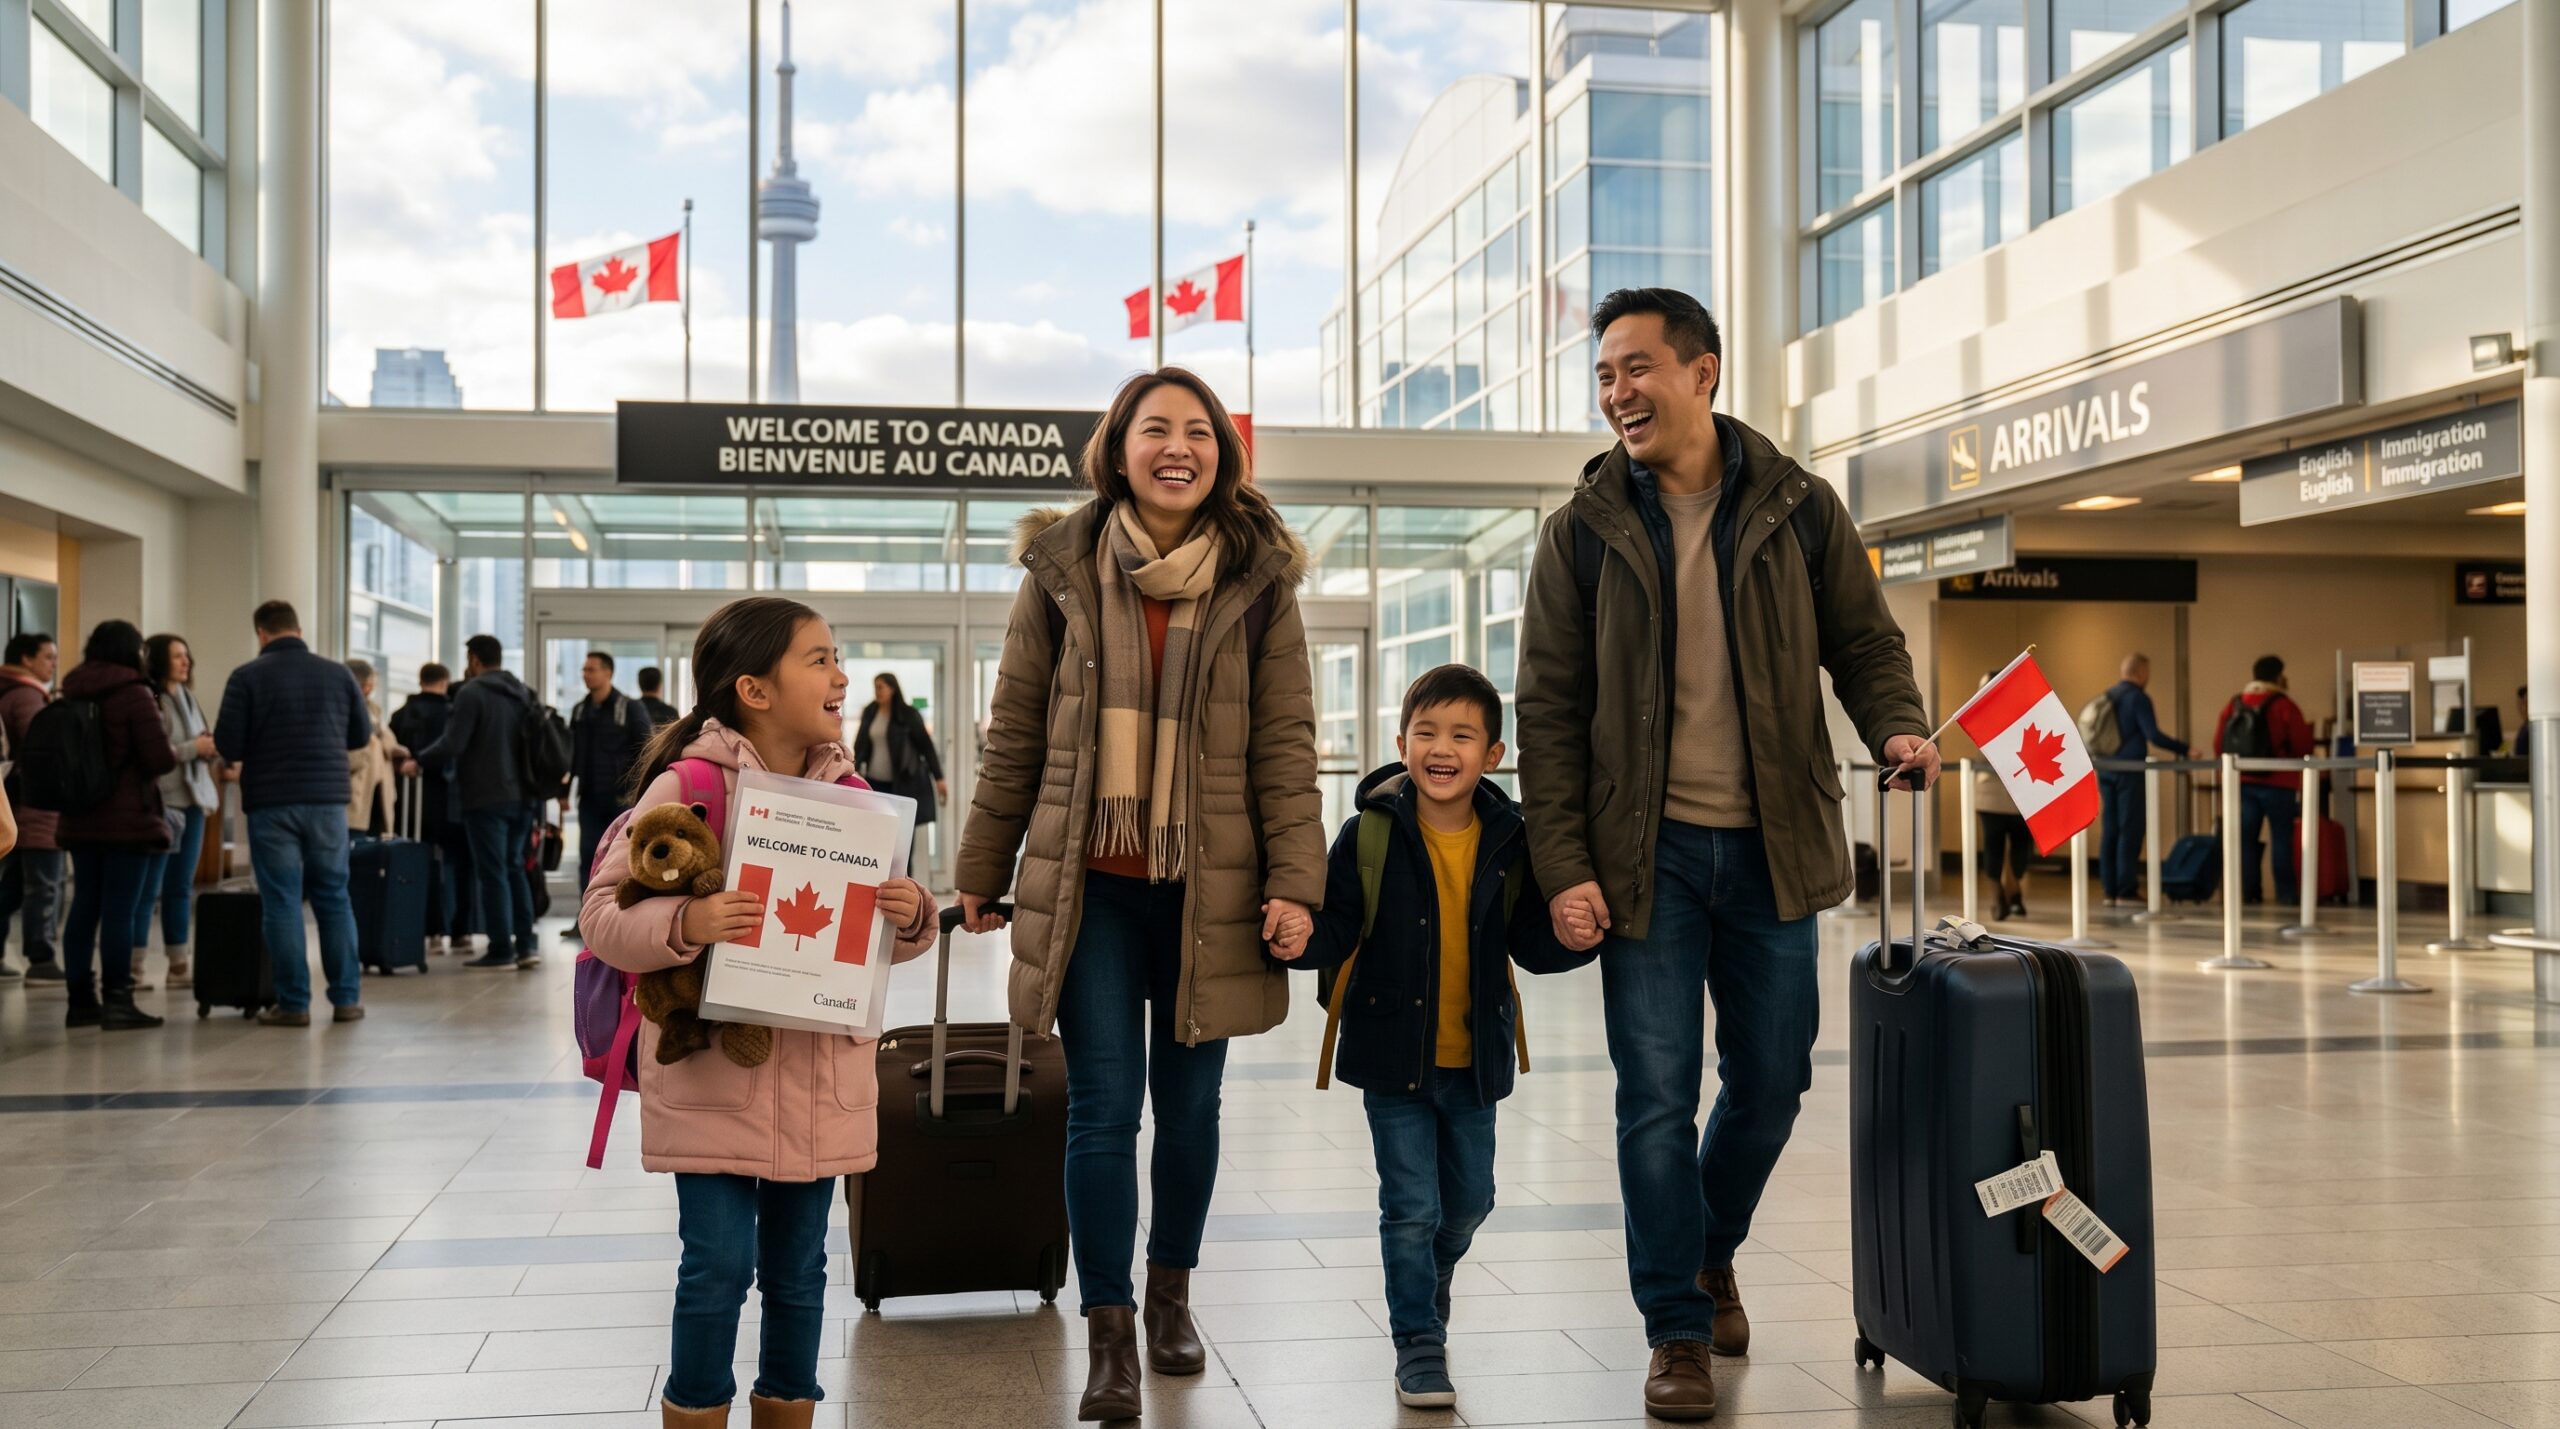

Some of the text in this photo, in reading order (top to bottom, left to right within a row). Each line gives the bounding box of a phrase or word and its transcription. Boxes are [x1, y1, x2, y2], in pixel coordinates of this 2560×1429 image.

[726, 416, 1064, 448] WELCOME TO CANADA
[1989, 381, 2150, 473] ARRIVALS
[719, 446, 1073, 478] BIENVENUE AU CANADA
[2299, 420, 2486, 478] English Immigration
[2381, 449, 2483, 486] Immigration
[1982, 567, 2059, 588] Arrivals
[747, 835, 879, 869] WELCOME TO CANADA
[813, 992, 857, 1011] Canada
